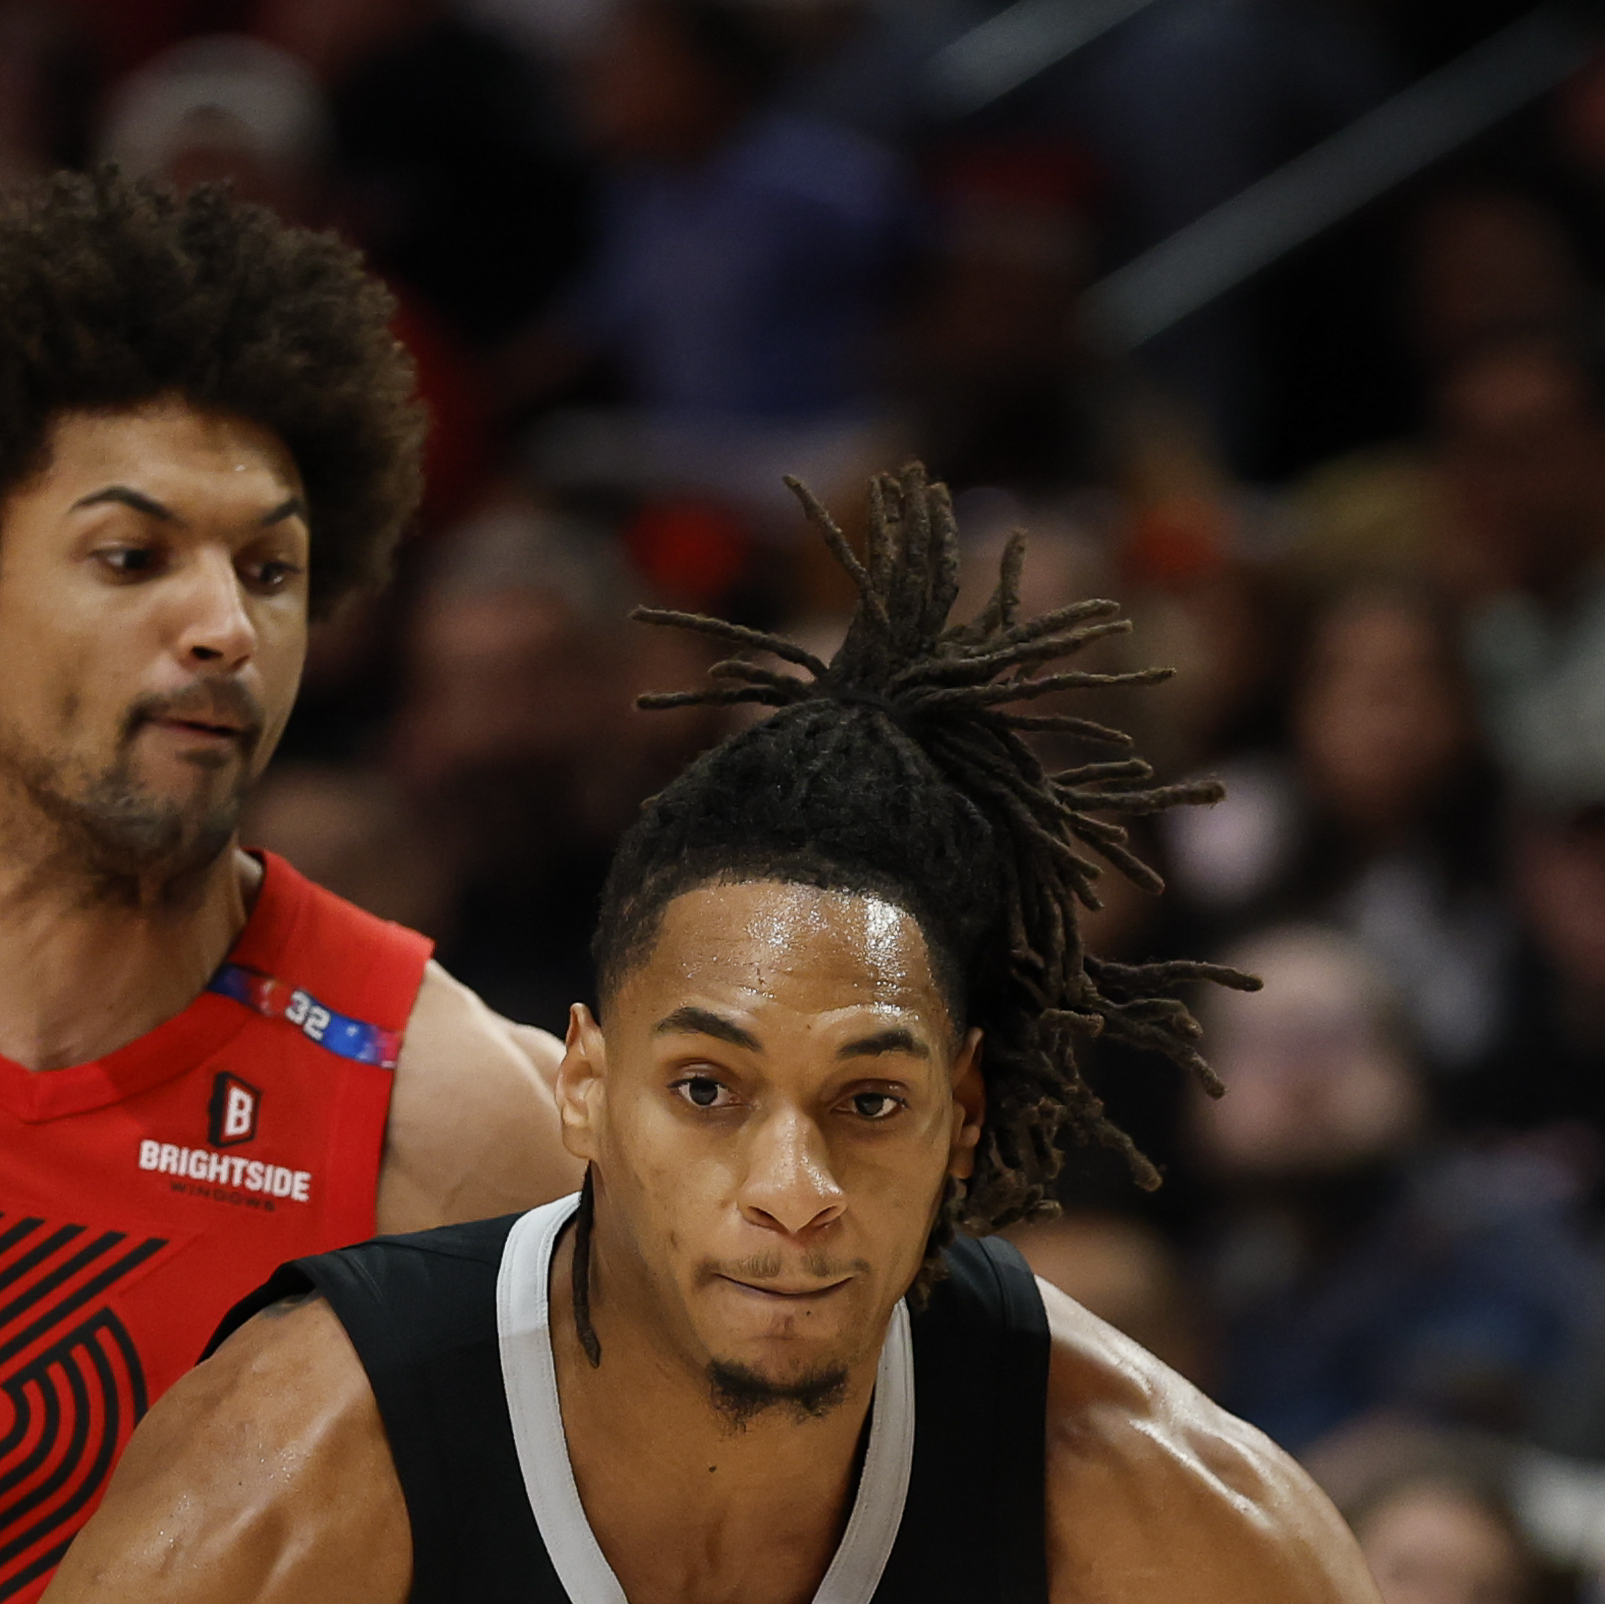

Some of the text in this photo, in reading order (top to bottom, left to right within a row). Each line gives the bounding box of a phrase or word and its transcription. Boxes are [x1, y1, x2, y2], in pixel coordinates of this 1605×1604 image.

[285, 989, 331, 1041] 32
[226, 1087, 253, 1136] B
[139, 1139, 312, 1202] BRIGHTSIDE
